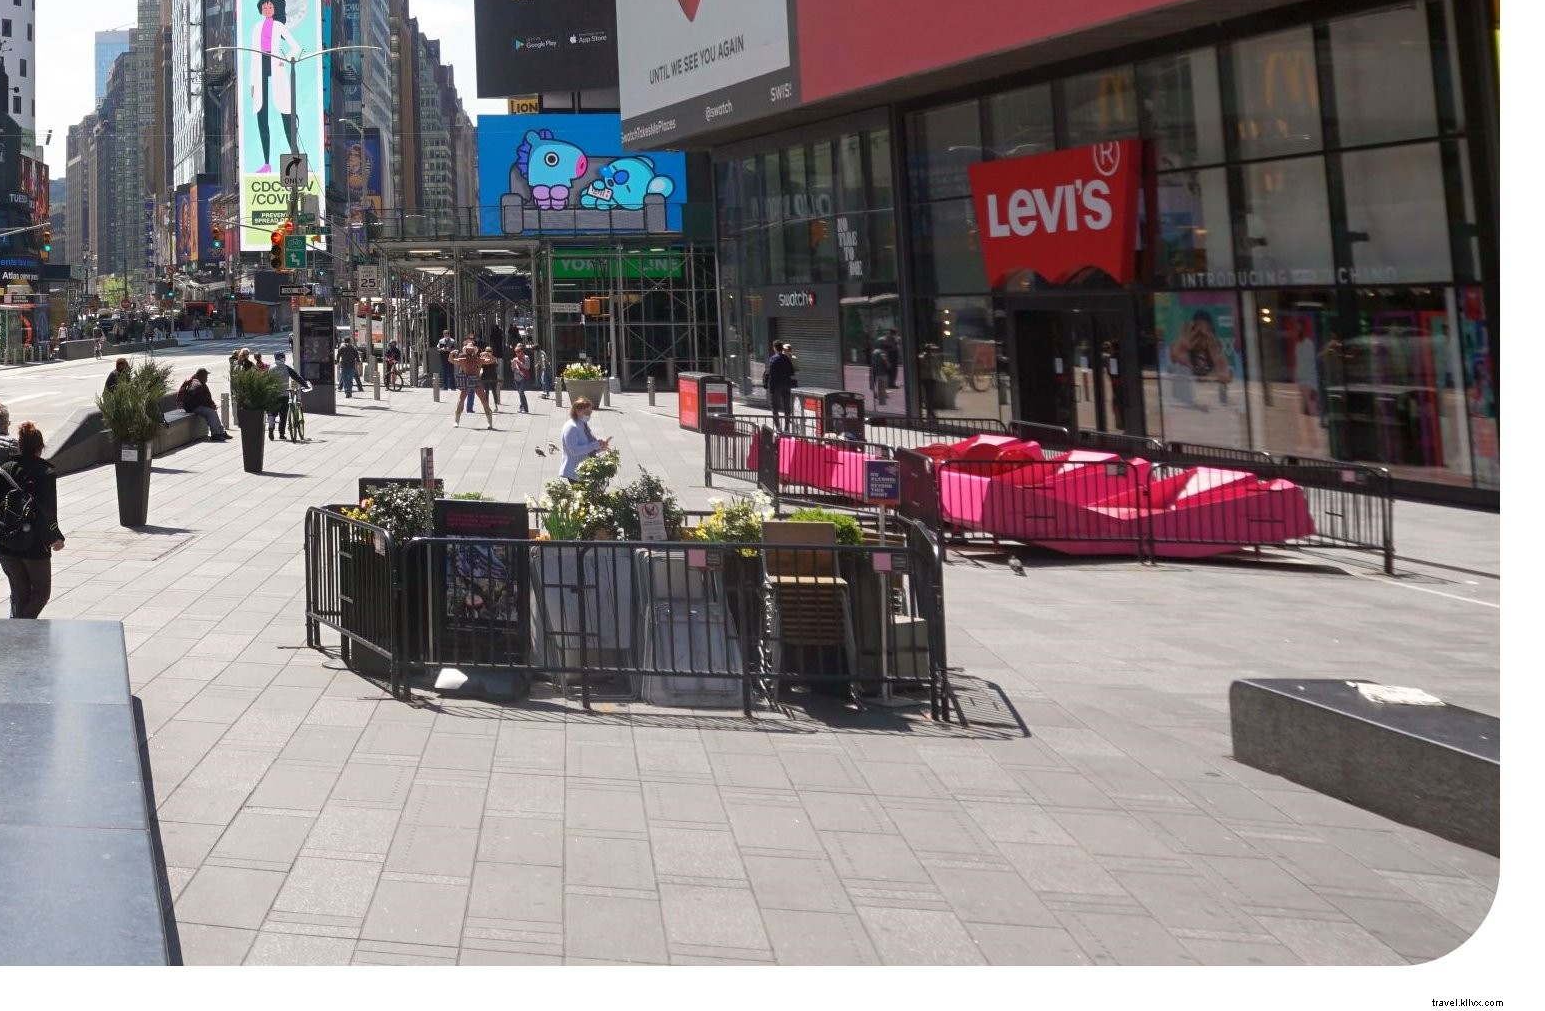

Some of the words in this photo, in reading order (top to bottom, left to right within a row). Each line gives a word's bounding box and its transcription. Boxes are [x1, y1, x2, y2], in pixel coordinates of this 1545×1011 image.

[579, 36, 591, 44] App
[649, 65, 671, 85] UNTIL
[671, 59, 683, 76] WE
[683, 51, 699, 72] SEE
[699, 45, 716, 65] YOU
[717, 34, 744, 60] AGAIN
[705, 99, 733, 122] @swatch
[837, 218, 849, 233] NO
[838, 231, 857, 247] TIME
[844, 247, 855, 261] TO
[360, 278, 375, 288] 25
[1181, 270, 1288, 288] INTRODUCING
[778, 291, 807, 307] swatch
